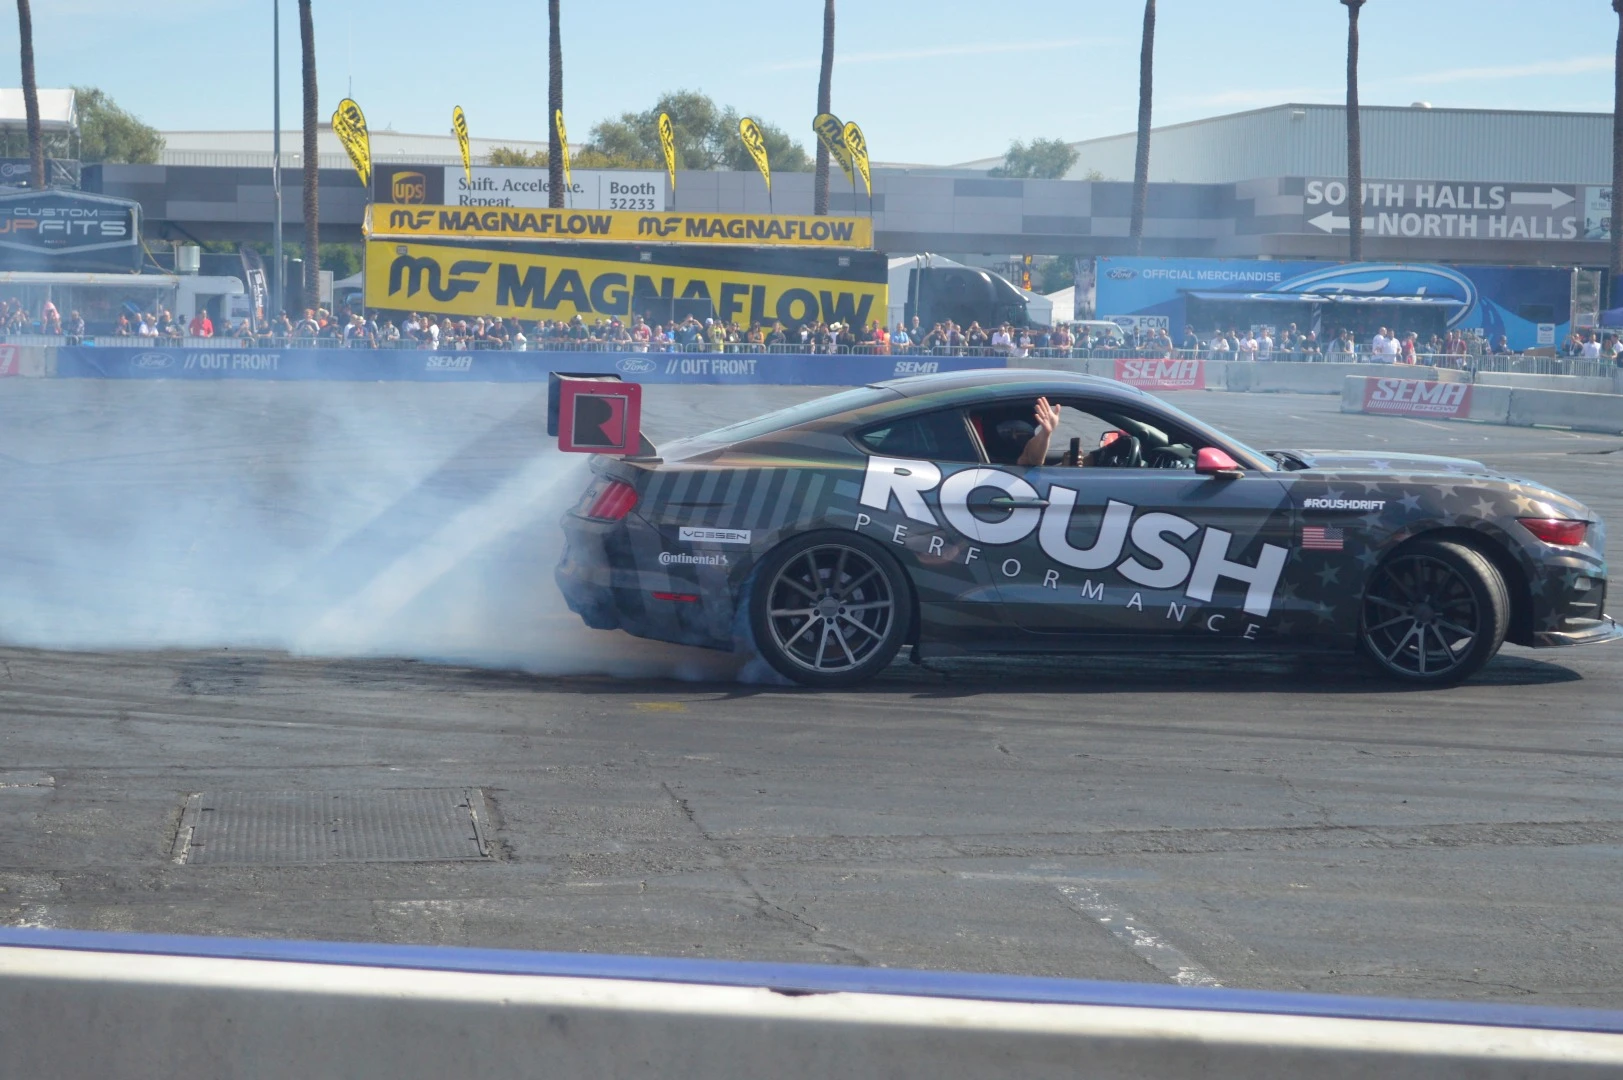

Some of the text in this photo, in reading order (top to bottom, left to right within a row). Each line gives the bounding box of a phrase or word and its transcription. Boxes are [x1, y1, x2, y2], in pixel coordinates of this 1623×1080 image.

[458, 177, 585, 194] Shift. Accelete.
[610, 181, 656, 195] Booth
[395, 183, 423, 205] ups
[459, 194, 515, 207] Repeat.
[1415, 184, 1505, 210] HALLS
[610, 198, 656, 210] 32233
[13, 207, 98, 217] CUSTOM
[438, 211, 613, 235] MAGNAFLOW
[685, 217, 855, 242] MAGNAFLOW
[1378, 212, 1578, 240] NORTH HALLS
[1142, 269, 1195, 281] OFFICIAL
[1196, 270, 1282, 282] MERCHANDISE
[1139, 317, 1168, 328] FCM
[200, 353, 230, 370] OUT
[232, 354, 281, 371] FRONT
[426, 355, 473, 367] SEMA
[681, 359, 710, 375] OUT
[711, 359, 757, 375] FRONT
[894, 361, 939, 373] SEMA
[1121, 360, 1199, 379] SEMA
[1371, 378, 1467, 406] SEMA
[1413, 404, 1456, 413] SHOW
[1303, 498, 1386, 511] #ROUSHDRIFT
[683, 530, 747, 540] VOSSEN
[859, 455, 1289, 618] ROUSH
[658, 552, 719, 565] Continental
[853, 512, 1261, 641] PERFORMANCE
